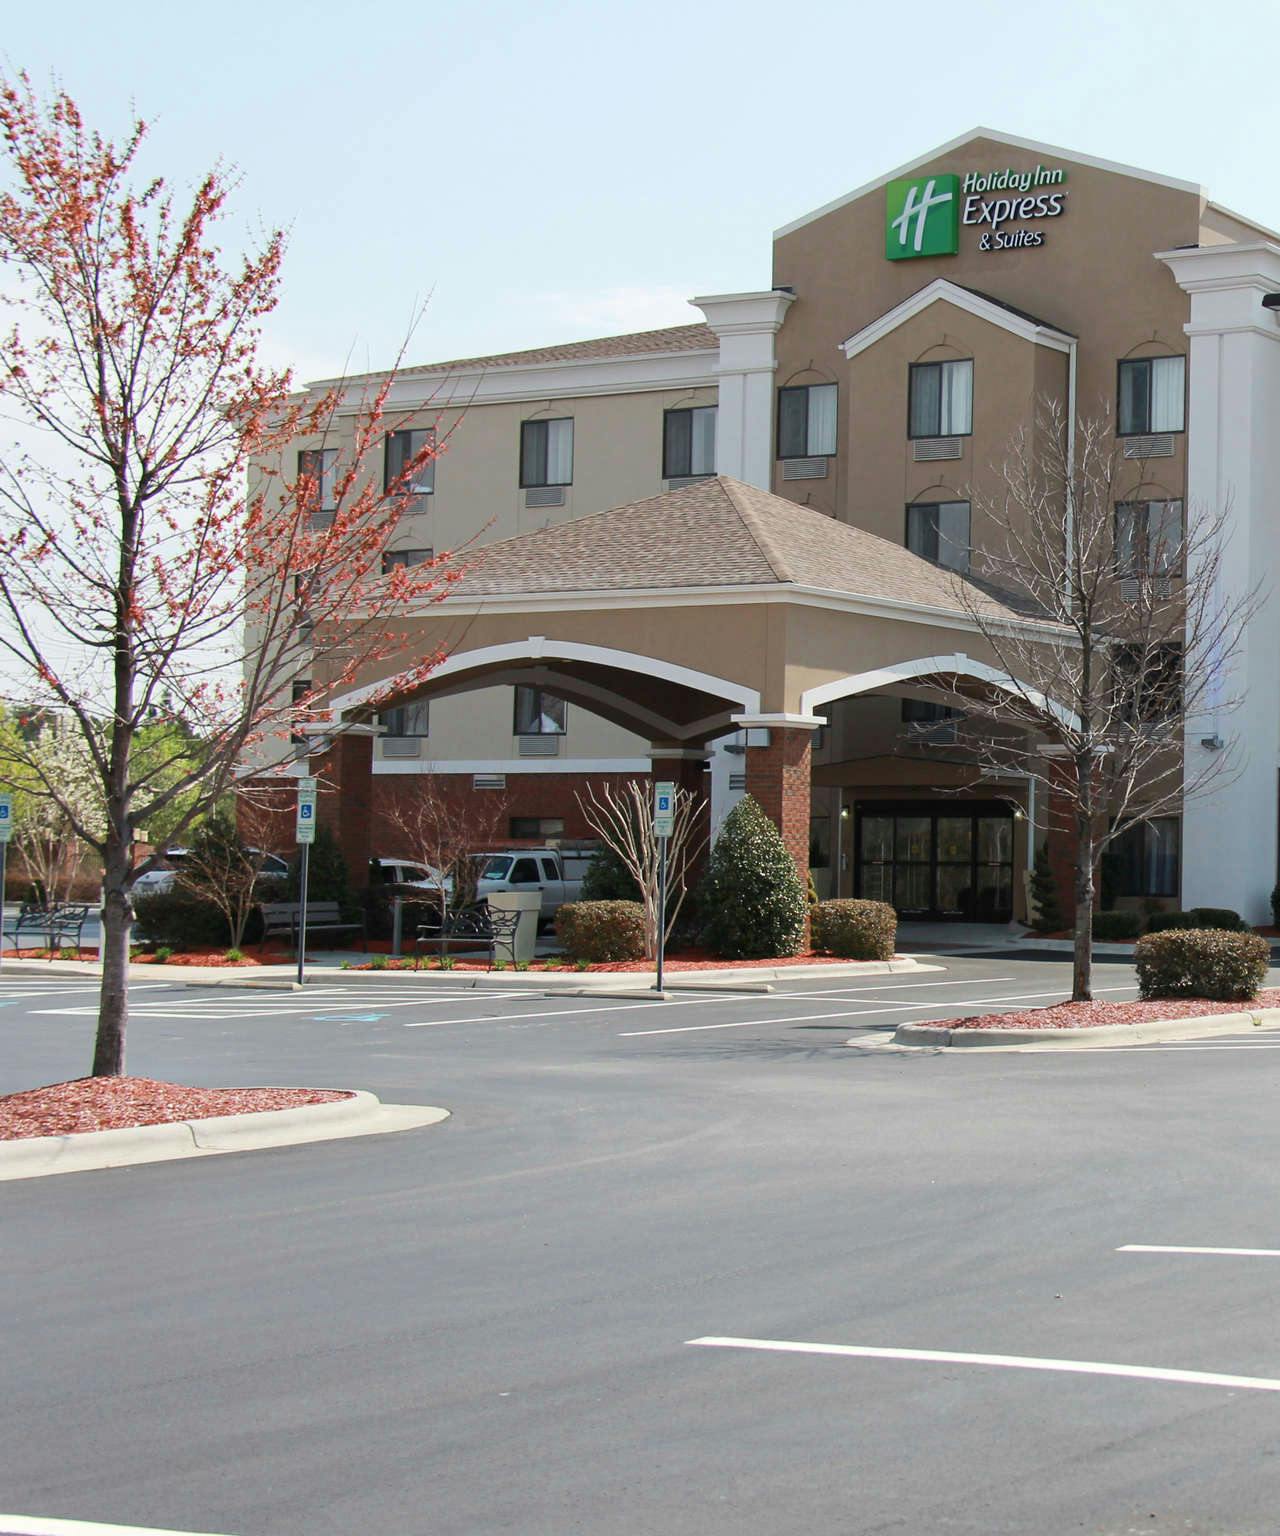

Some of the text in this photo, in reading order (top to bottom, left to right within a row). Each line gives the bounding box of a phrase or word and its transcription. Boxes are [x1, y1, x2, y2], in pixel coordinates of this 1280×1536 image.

[963, 164, 1063, 194] Holiday Inn
[962, 193, 1063, 229] Express
[978, 229, 1043, 251] & Suites
